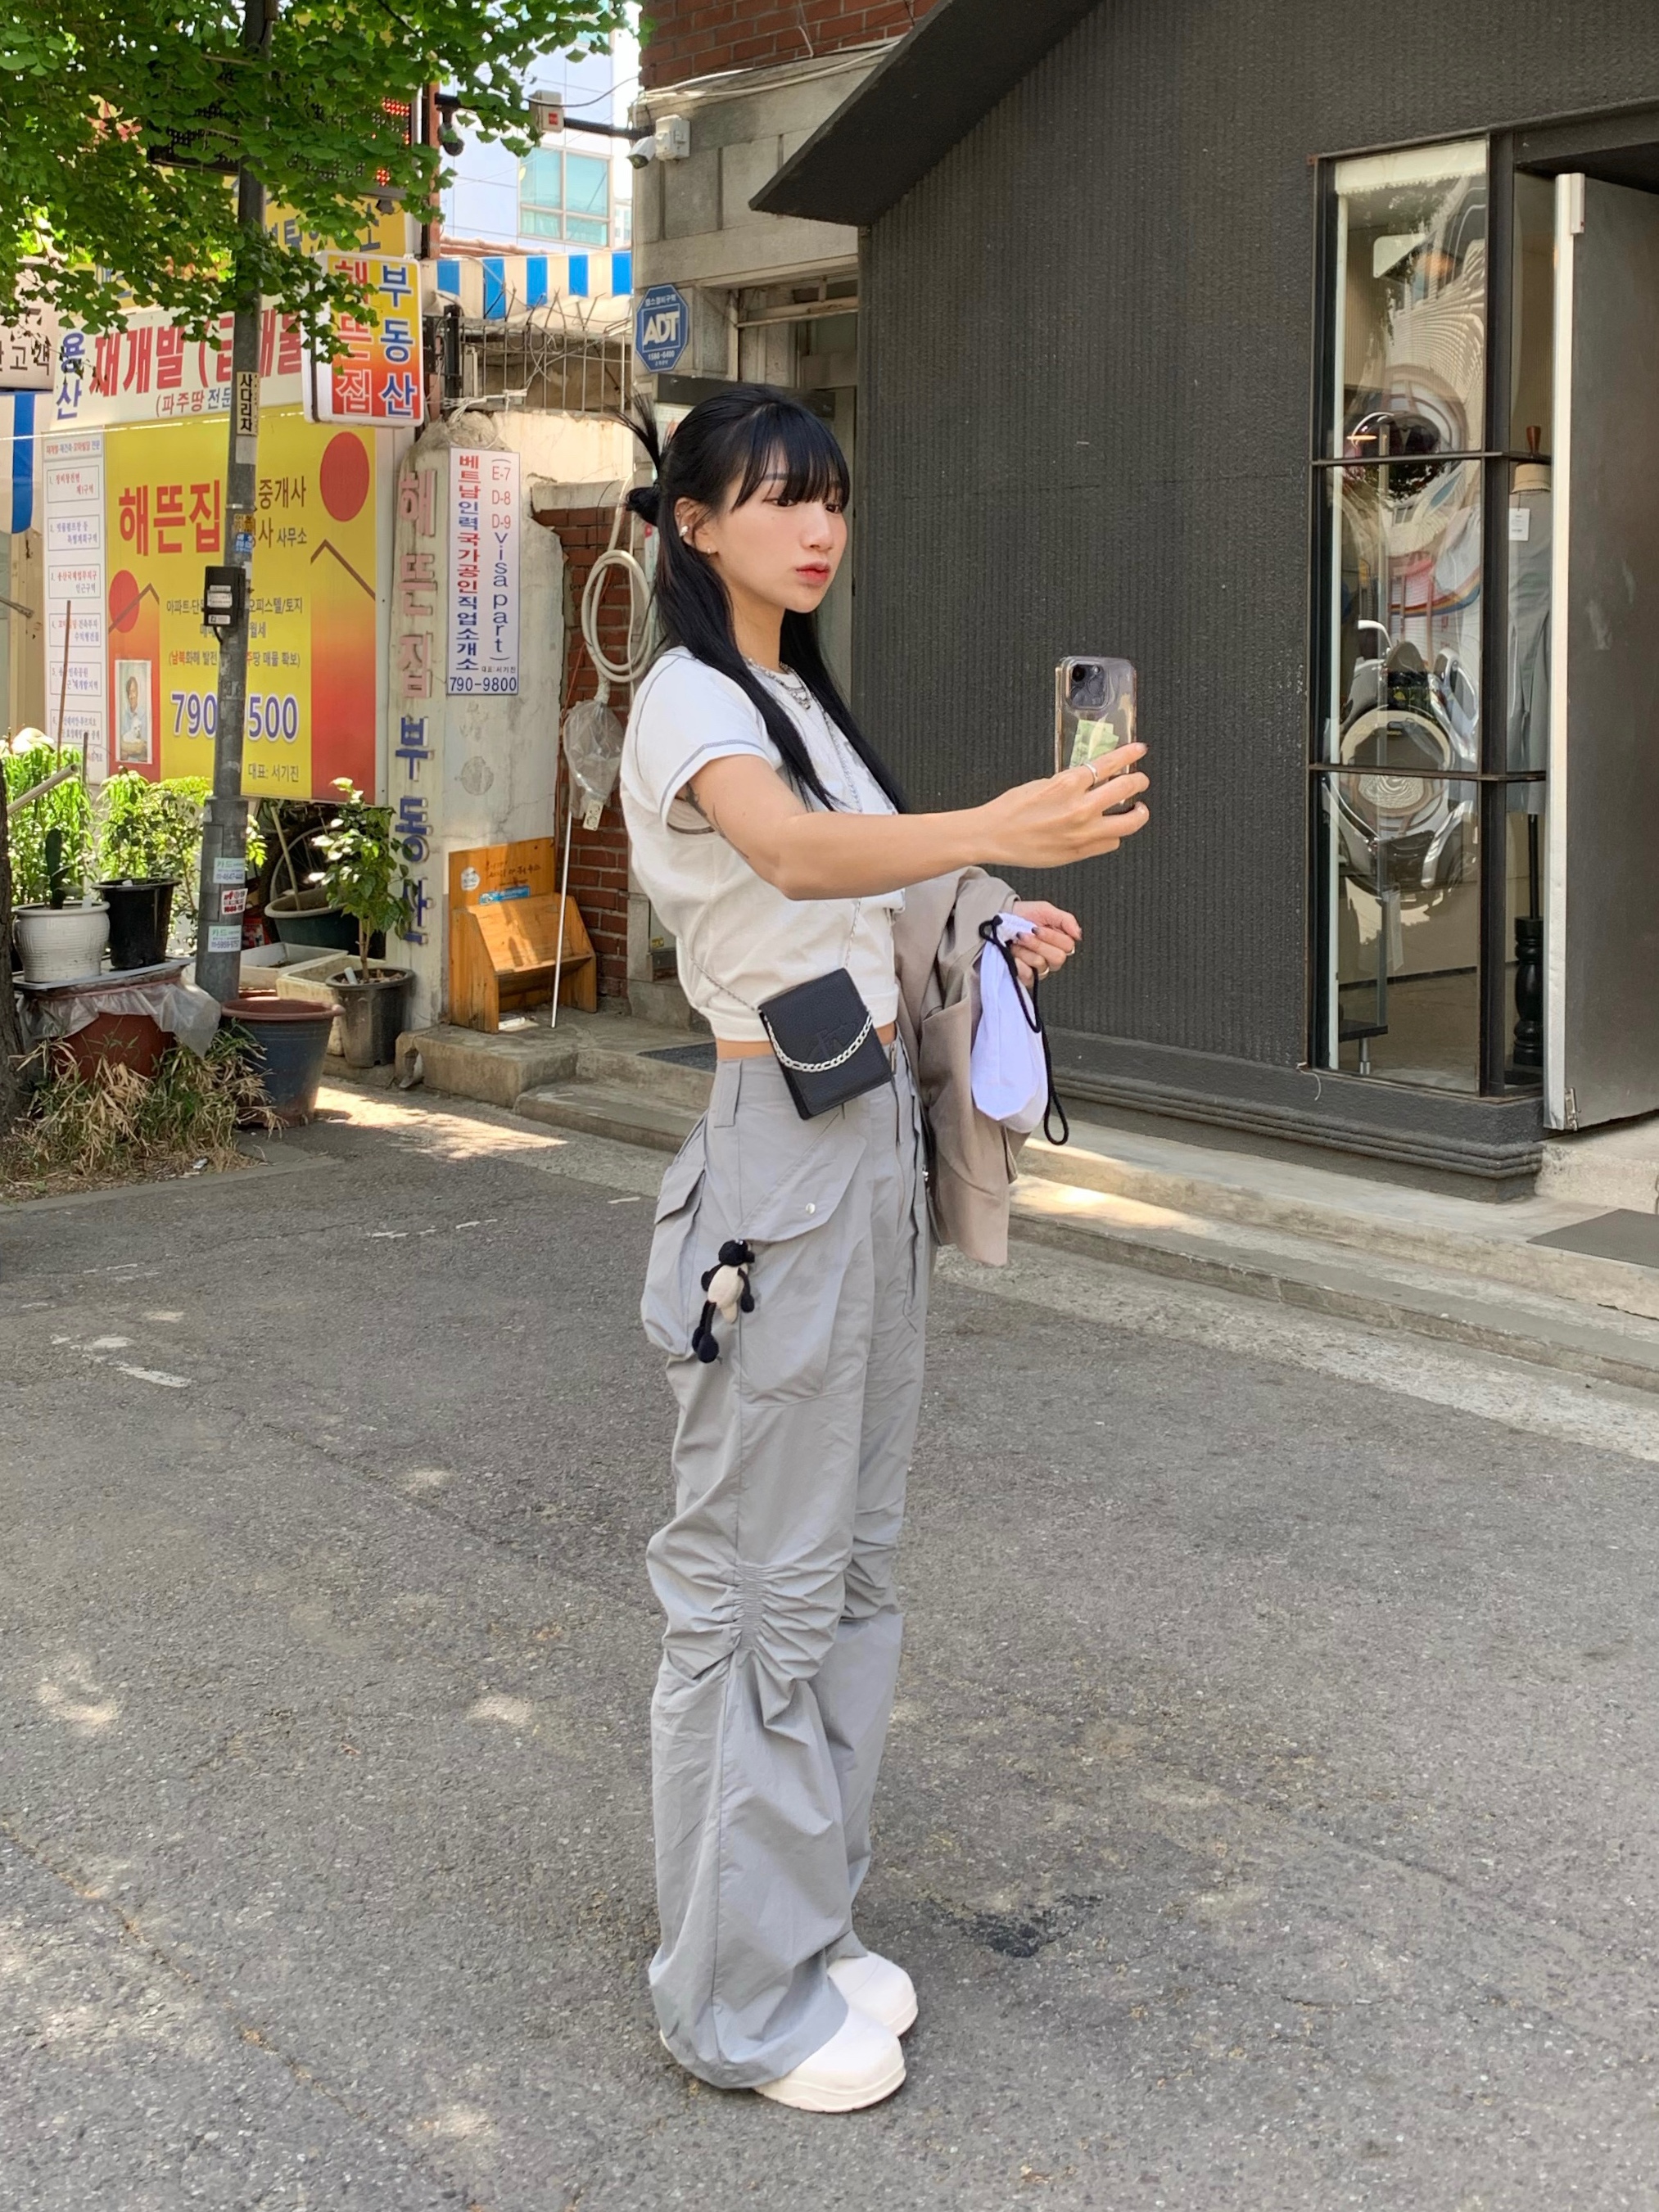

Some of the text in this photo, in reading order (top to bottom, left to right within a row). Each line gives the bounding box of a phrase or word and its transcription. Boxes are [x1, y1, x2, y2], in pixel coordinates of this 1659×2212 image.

[379, 264, 415, 415] 부동산
[643, 311, 680, 345] ADT
[0, 341, 49, 374] 고객
[57, 332, 86, 419] 용산
[119, 479, 219, 557] 해뜬집
[276, 527, 308, 547] 사무소
[450, 677, 518, 692] 790-9800
[271, 764, 300, 783] 서기진
